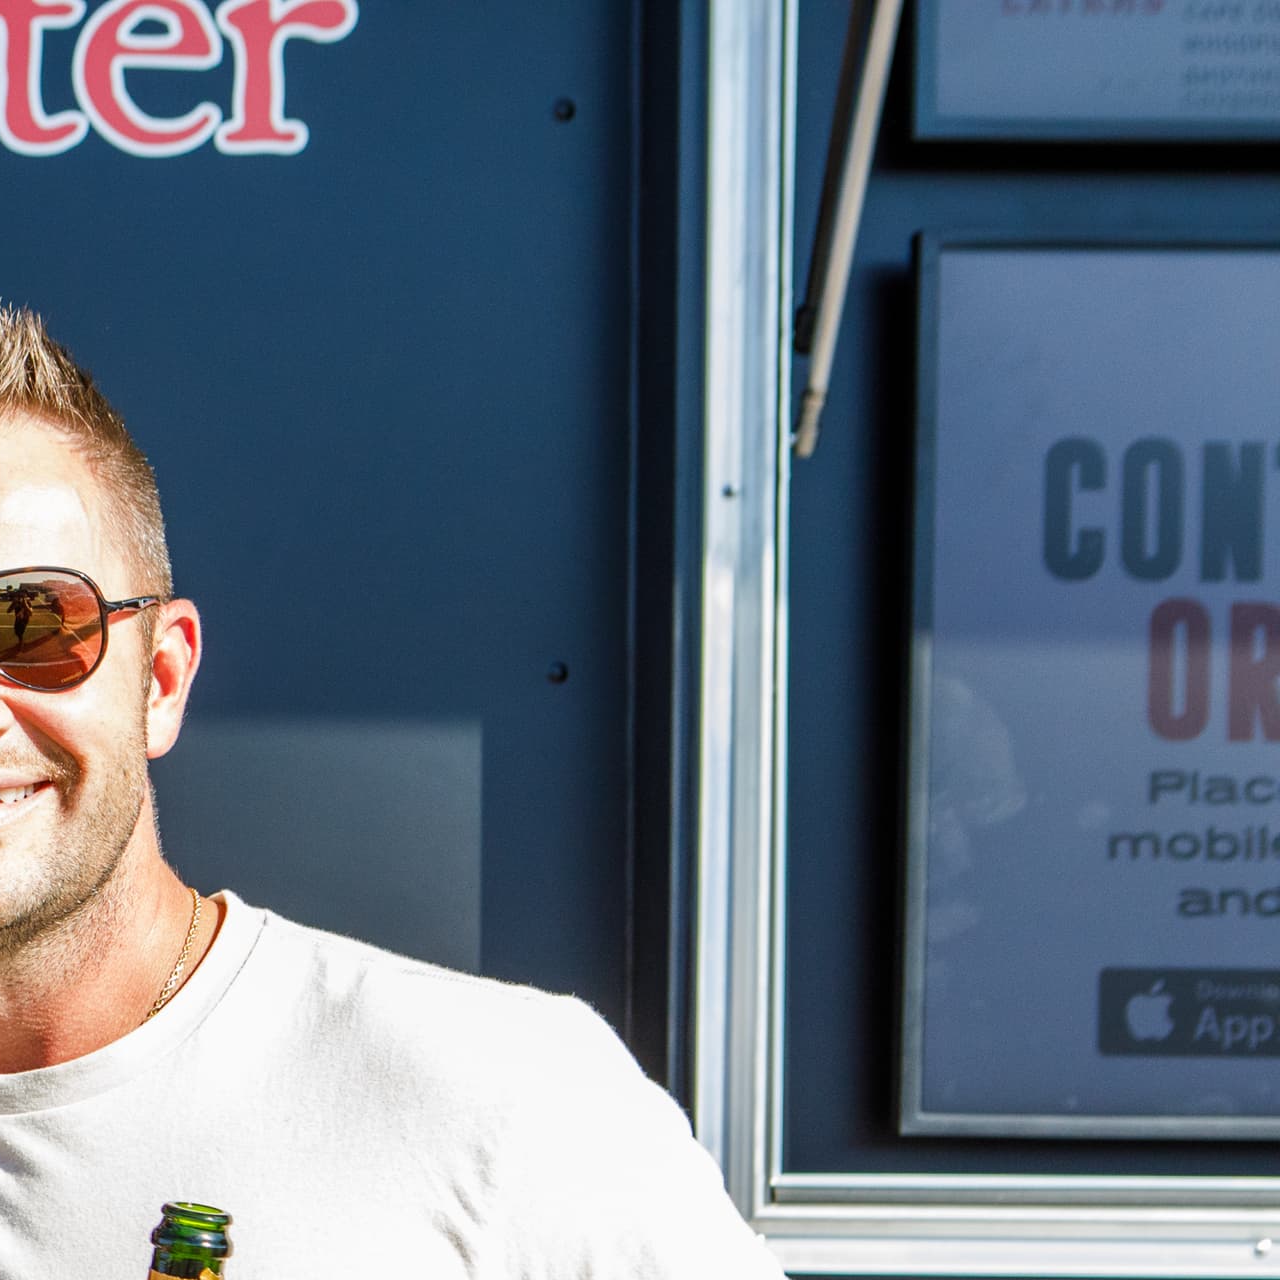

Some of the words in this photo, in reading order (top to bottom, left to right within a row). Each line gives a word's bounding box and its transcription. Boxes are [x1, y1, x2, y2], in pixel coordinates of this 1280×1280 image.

[1042, 436, 1280, 584] CON
[1150, 768, 1280, 805] Plac
[1193, 1006, 1276, 1051] App
